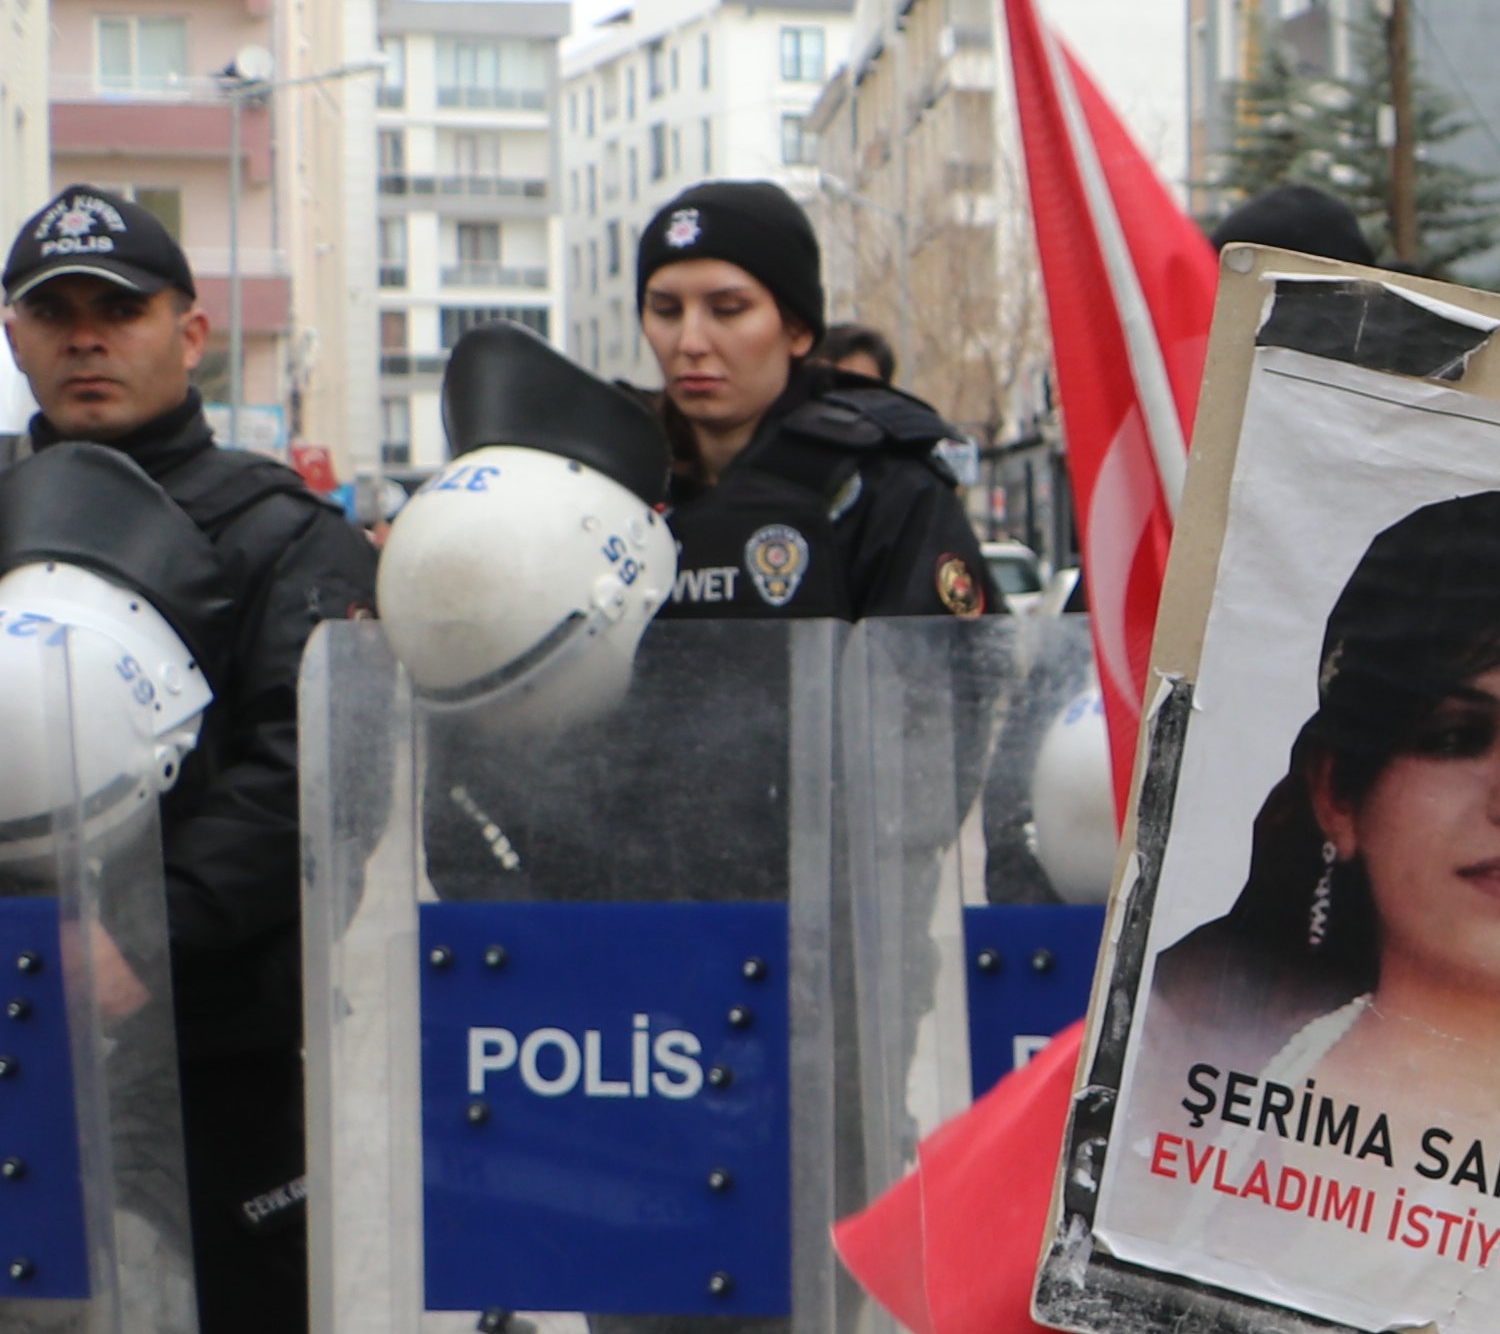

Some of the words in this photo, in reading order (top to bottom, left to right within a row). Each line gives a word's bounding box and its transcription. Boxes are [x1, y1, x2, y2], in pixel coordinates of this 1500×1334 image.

[467, 1013, 704, 1100] POLİS
[1181, 1063, 1395, 1168] ŞERİMA
[1150, 1131, 1376, 1234] EVLADIMI
